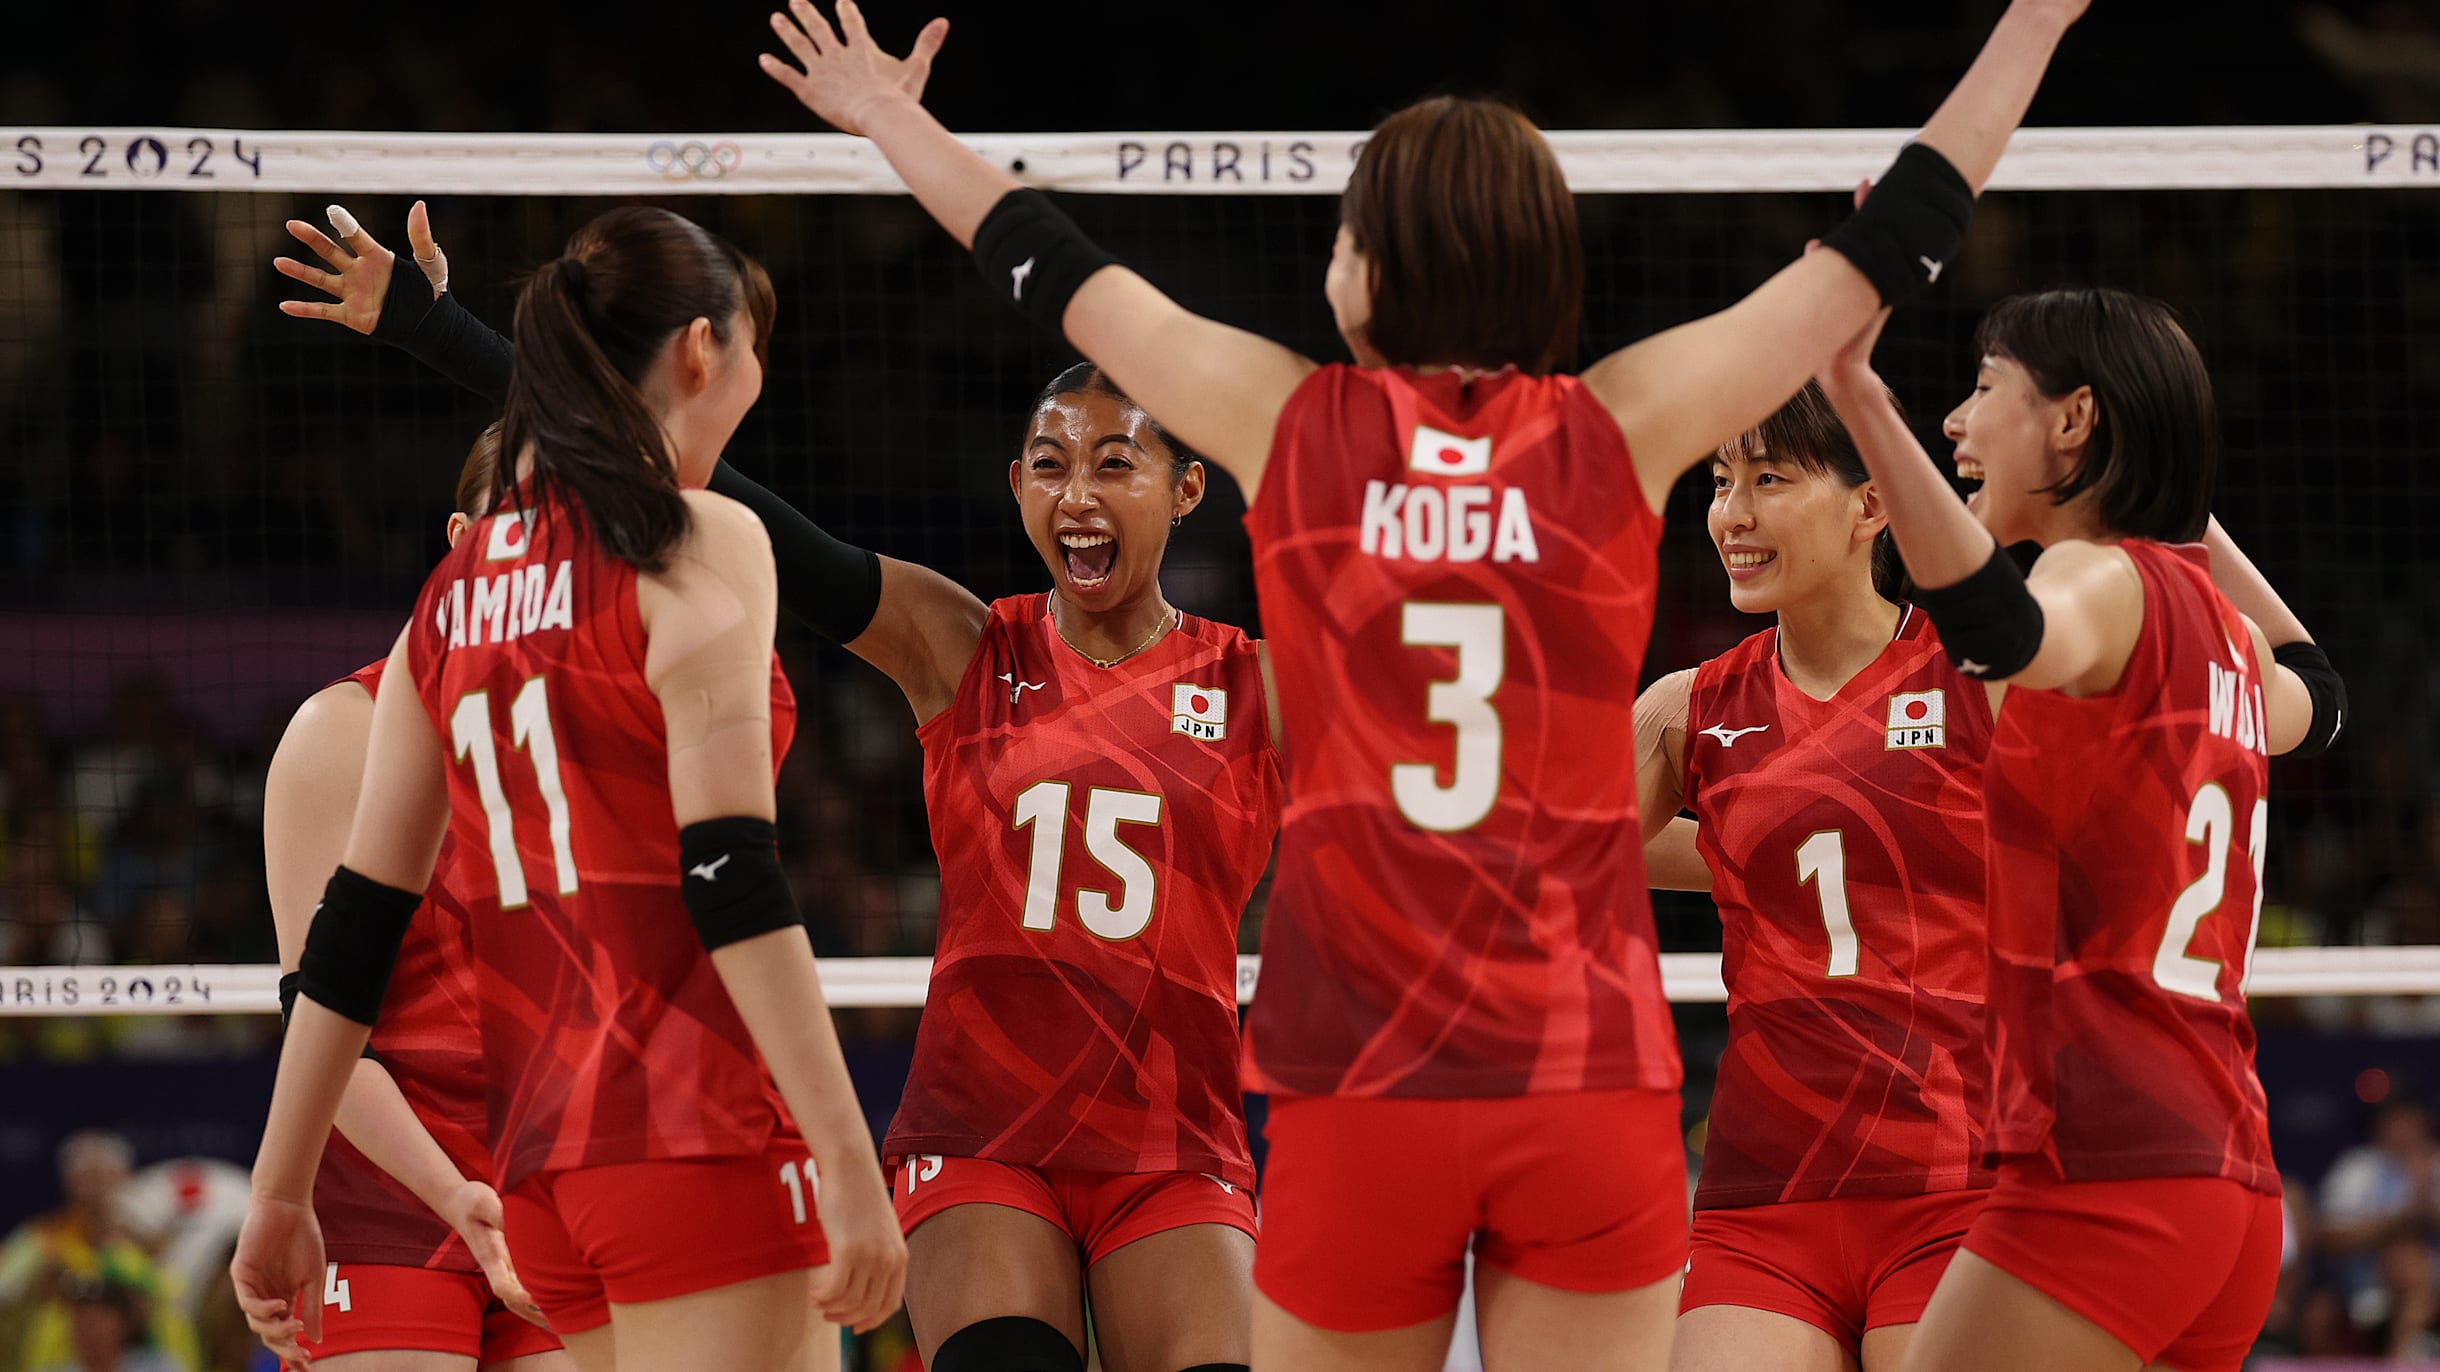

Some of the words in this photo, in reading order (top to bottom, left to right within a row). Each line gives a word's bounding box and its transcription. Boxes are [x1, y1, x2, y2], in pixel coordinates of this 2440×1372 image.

[1117, 140, 1316, 182] PARIS
[1359, 479, 1540, 563] KOGA
[449, 672, 579, 911] 11
[1180, 718, 1215, 738] JPN
[1390, 600, 1506, 834] 3
[1895, 728, 1934, 746] JPN
[1012, 778, 1166, 943] 15
[1794, 828, 1861, 979] 1
[2151, 779, 2269, 1002] 21
